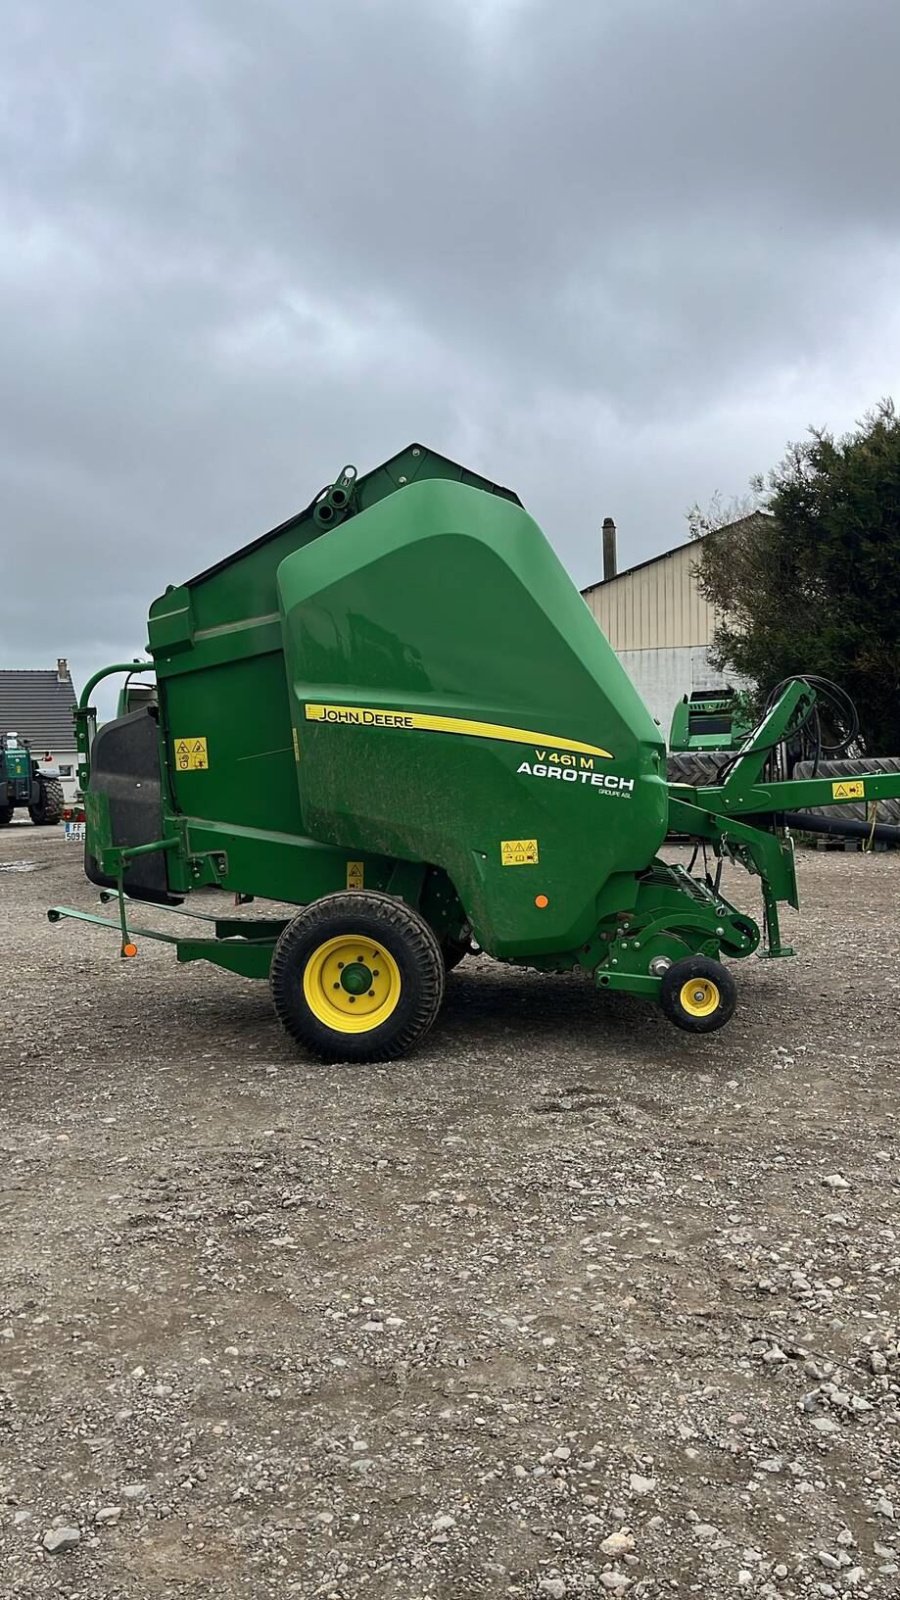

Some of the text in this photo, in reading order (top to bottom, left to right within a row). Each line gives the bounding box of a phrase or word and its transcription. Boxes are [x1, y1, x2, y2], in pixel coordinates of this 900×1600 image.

[319, 708, 413, 727] JOHN DEERE
[535, 749, 594, 770] V 461 M
[516, 762, 635, 791] AGROTECH
[598, 788, 620, 798] GROUPE
